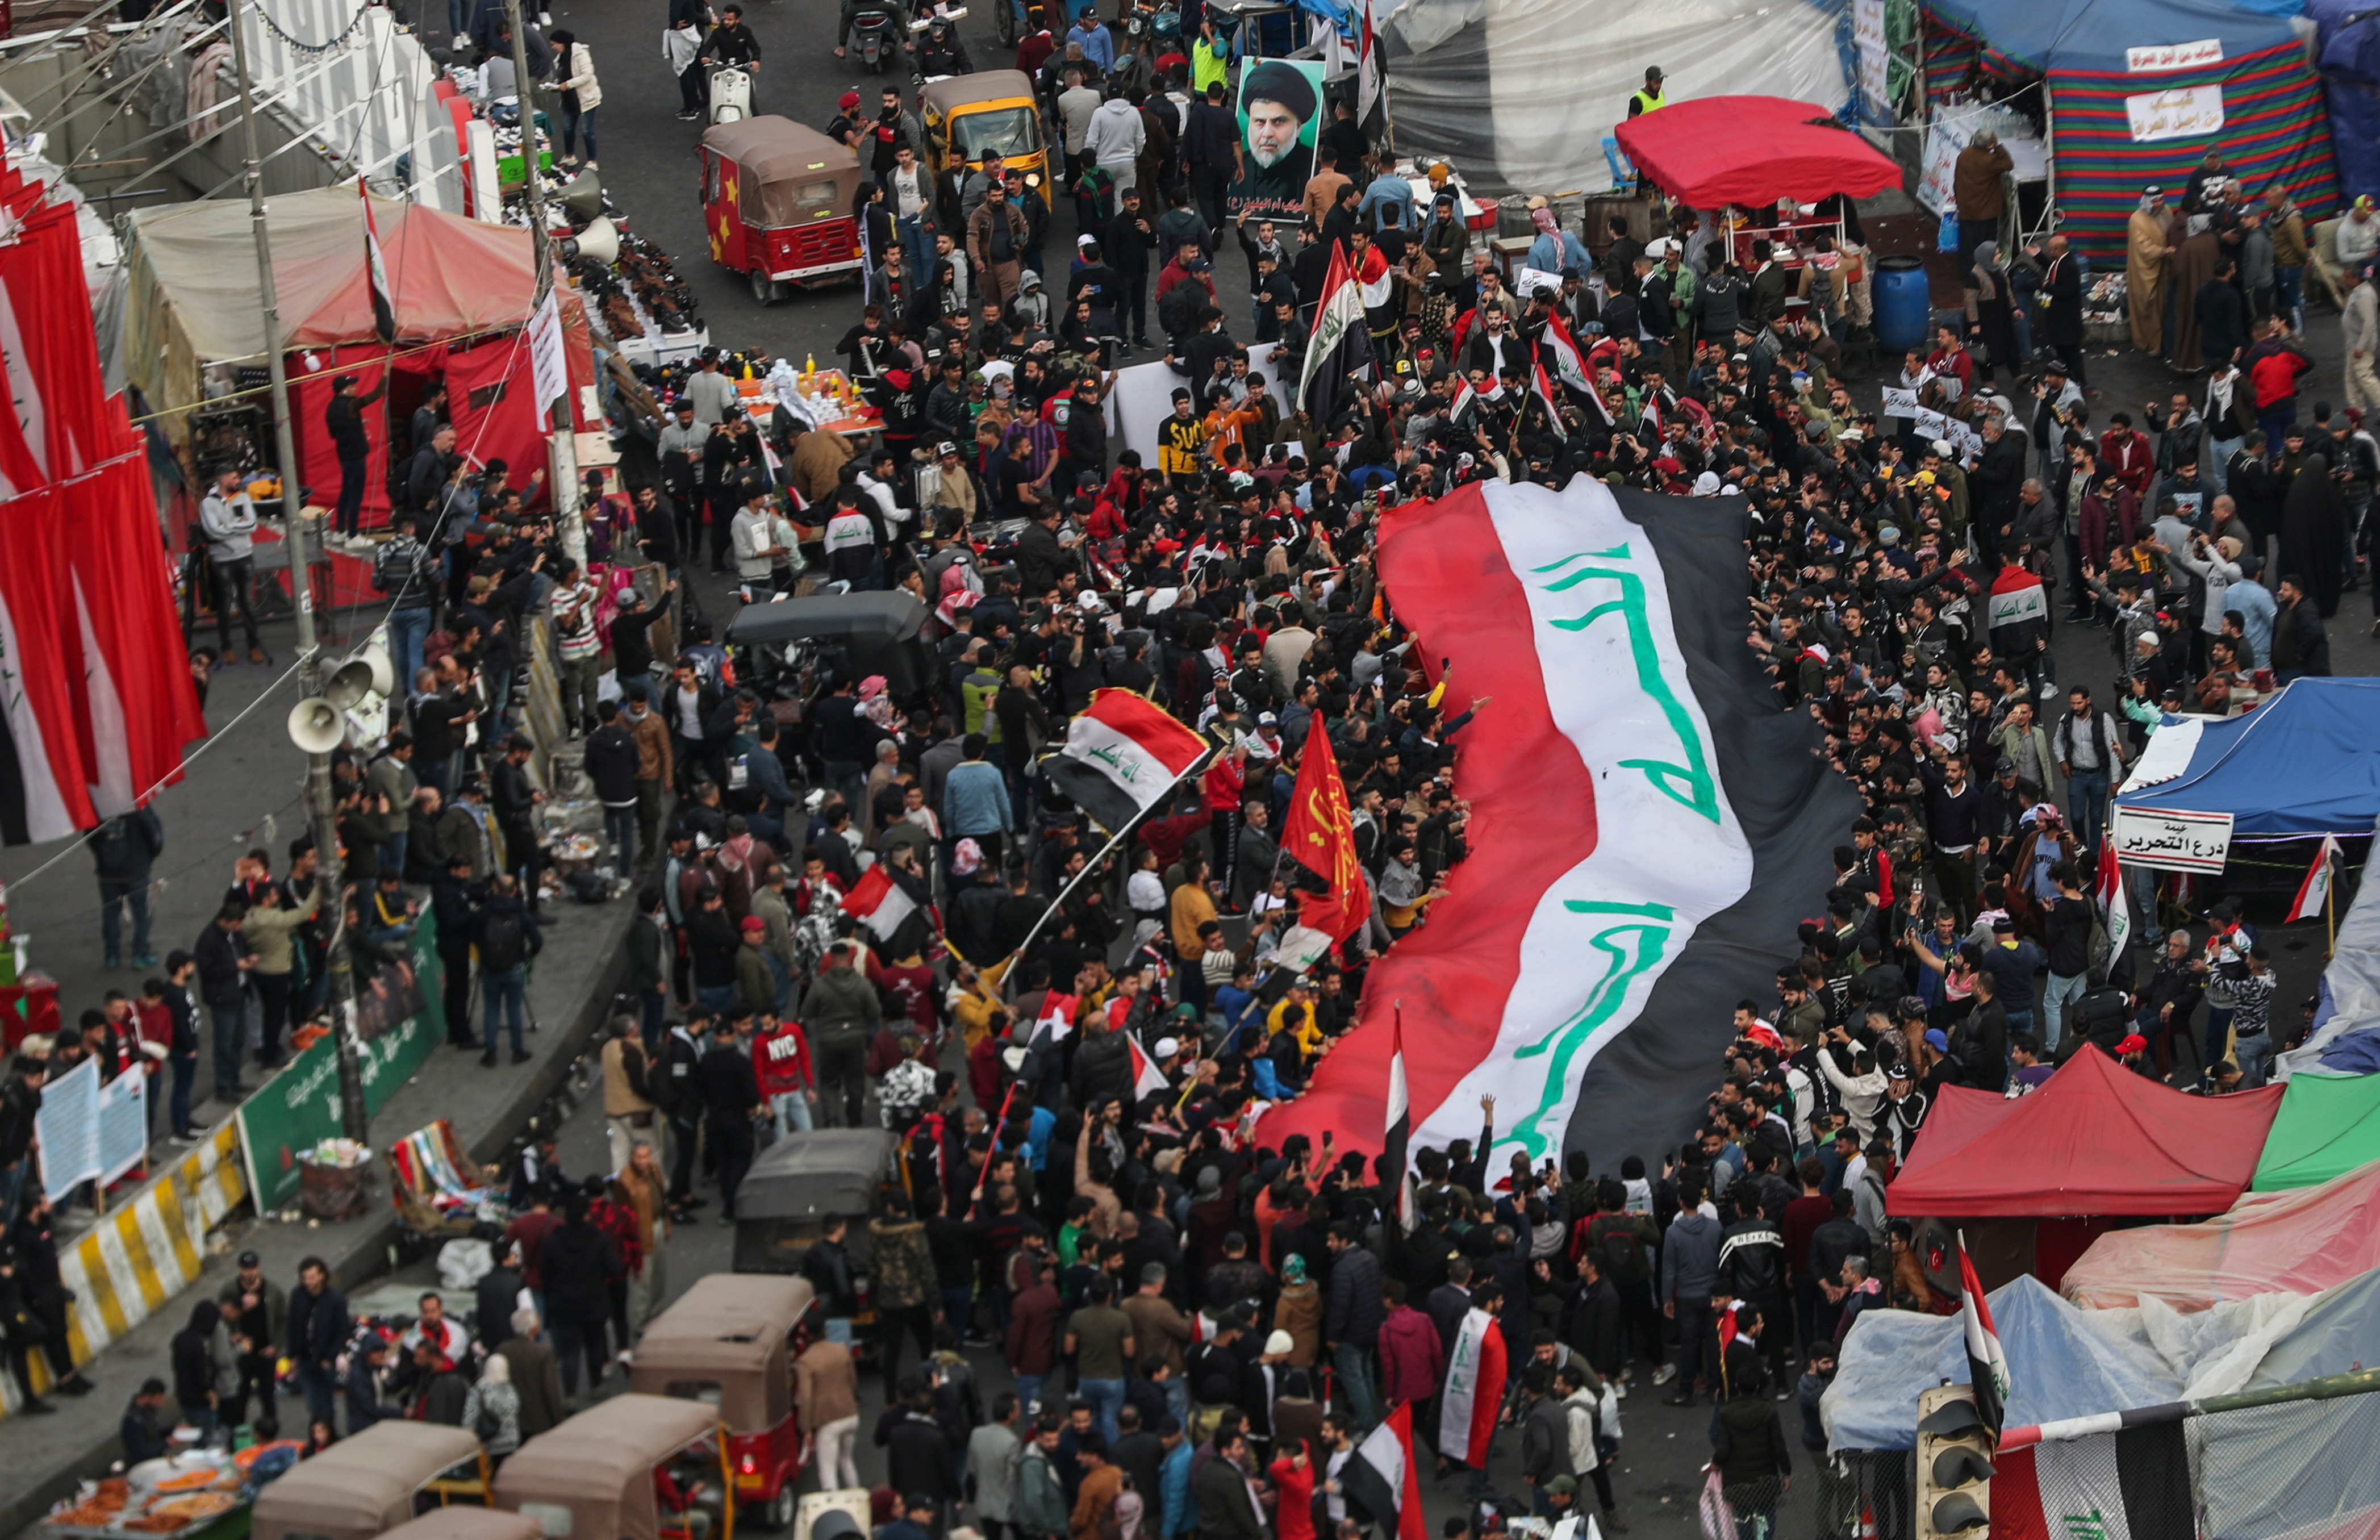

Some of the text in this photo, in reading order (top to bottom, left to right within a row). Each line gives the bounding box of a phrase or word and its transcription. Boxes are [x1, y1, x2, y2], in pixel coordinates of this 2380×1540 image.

[2164, 822, 2188, 834] خيمة
[2123, 835, 2224, 857] درع التحرير
[767, 1034, 797, 1061] NYC
